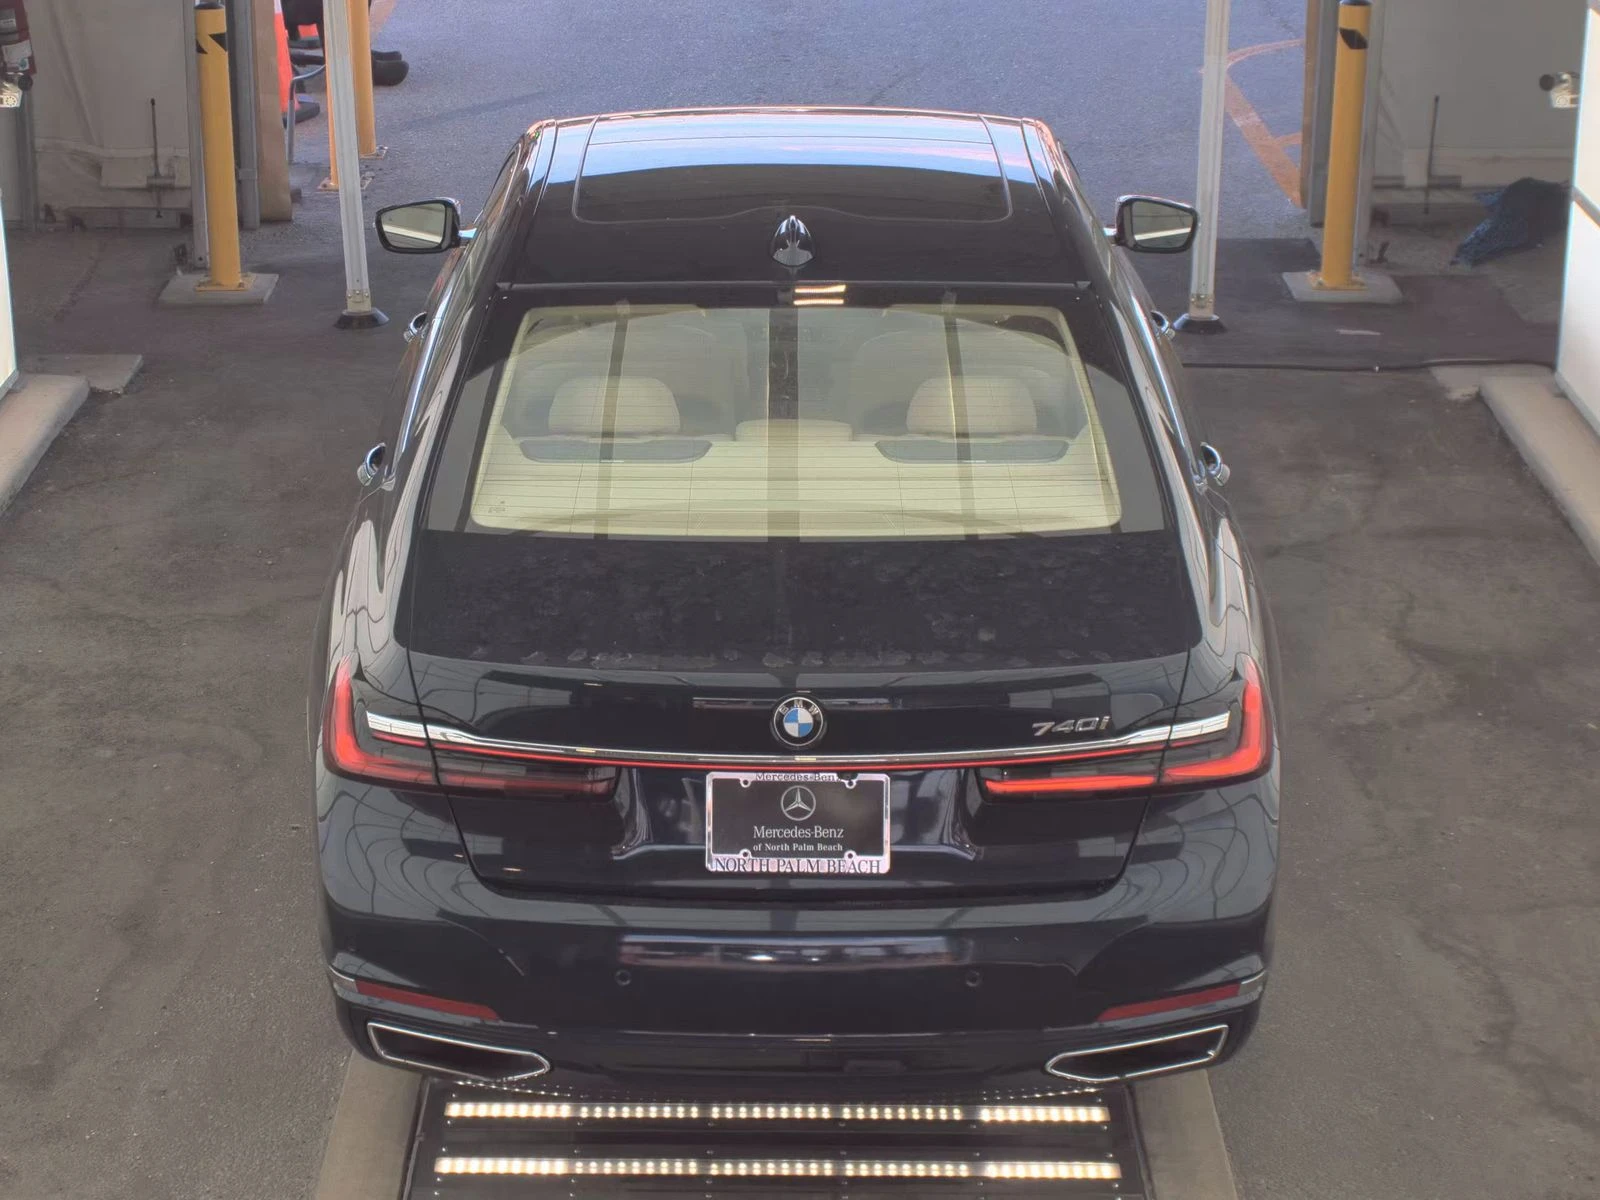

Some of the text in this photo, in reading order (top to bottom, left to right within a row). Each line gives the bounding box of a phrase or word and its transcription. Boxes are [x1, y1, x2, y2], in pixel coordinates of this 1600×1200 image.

[779, 699, 820, 715] BMW
[1032, 715, 1110, 736] 740i
[755, 772, 841, 782] Mercedes-Ben
[753, 825, 844, 839] Mercedes-Benz
[753, 843, 843, 851] of North Palm Beach
[714, 858, 881, 874] NORTH PALM BEACH
